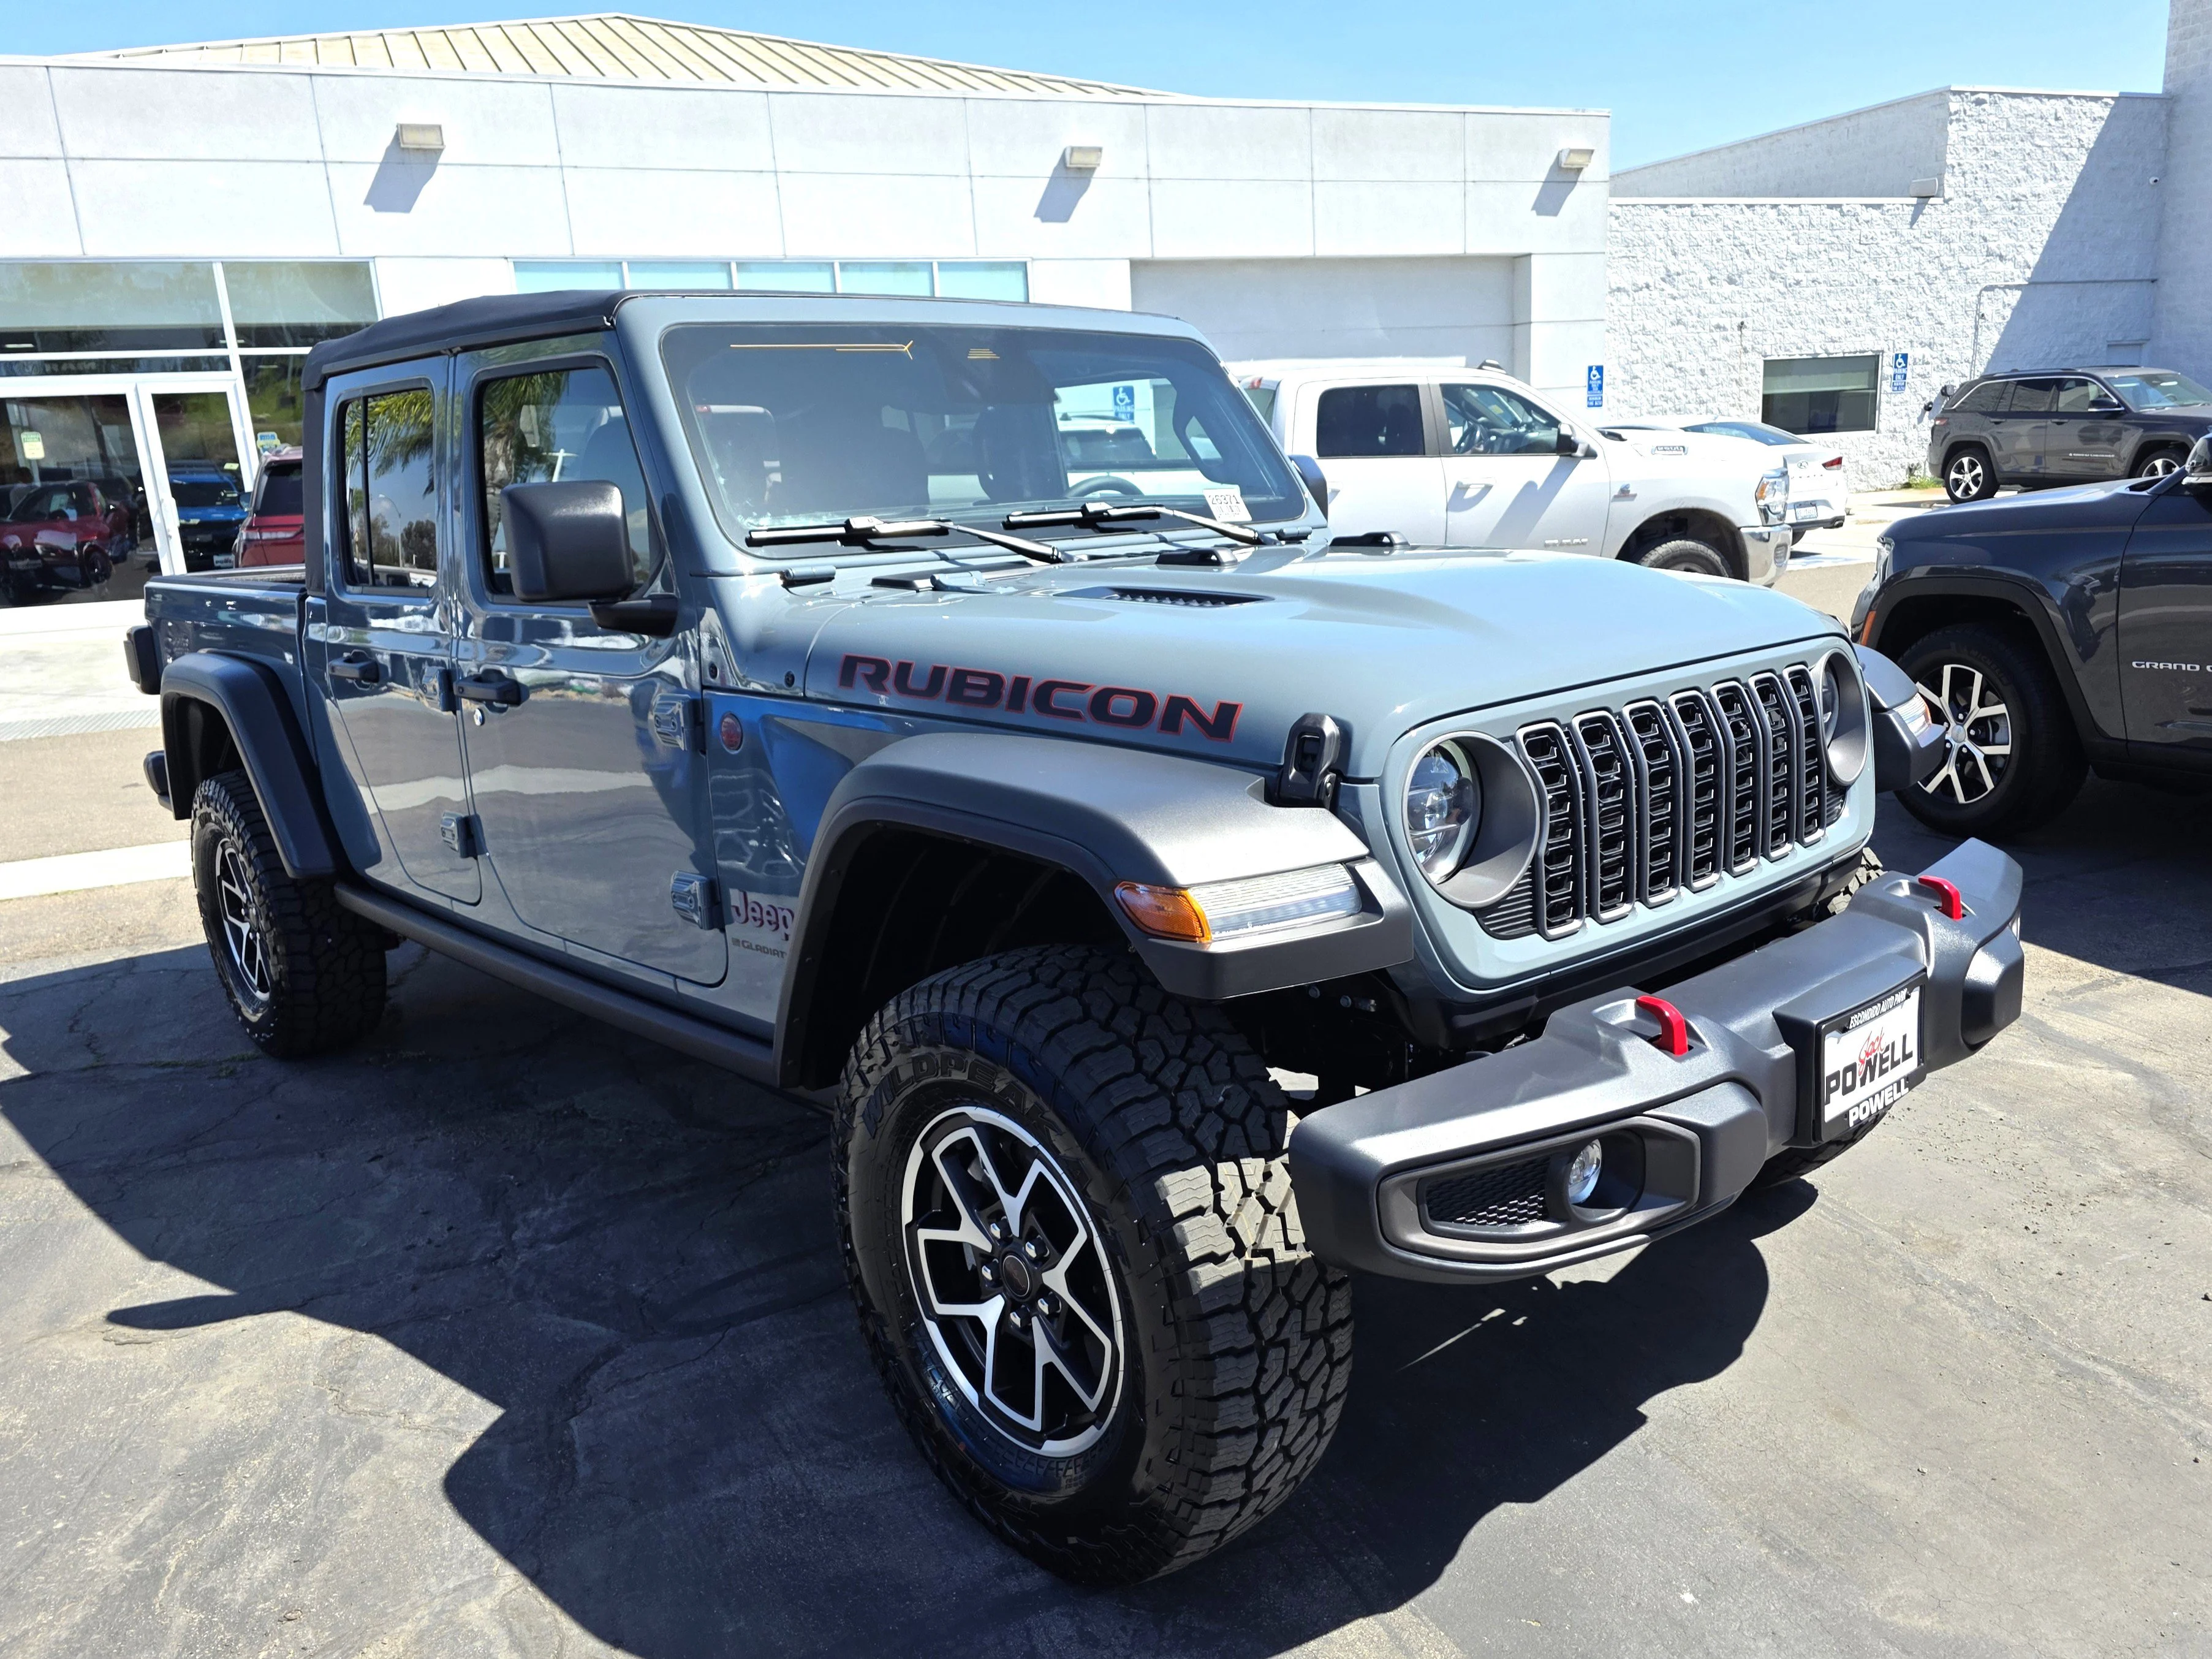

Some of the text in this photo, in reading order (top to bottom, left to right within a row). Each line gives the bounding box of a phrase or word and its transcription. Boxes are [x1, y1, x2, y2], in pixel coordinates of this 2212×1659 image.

[1209, 494, 1240, 505] 26371
[2132, 661, 2200, 671] GRAND
[838, 653, 1243, 743] RUBICON
[731, 890, 795, 941] Jeep
[741, 940, 788, 959] GLADIAT
[1849, 987, 1907, 1030] ESCONDIDO AUTO PARK
[1825, 1033, 1913, 1106] POWELL
[1858, 1027, 1885, 1077] Jack
[862, 1050, 1064, 1156] WILDPEAK
[1849, 1078, 1909, 1128] POWELL
